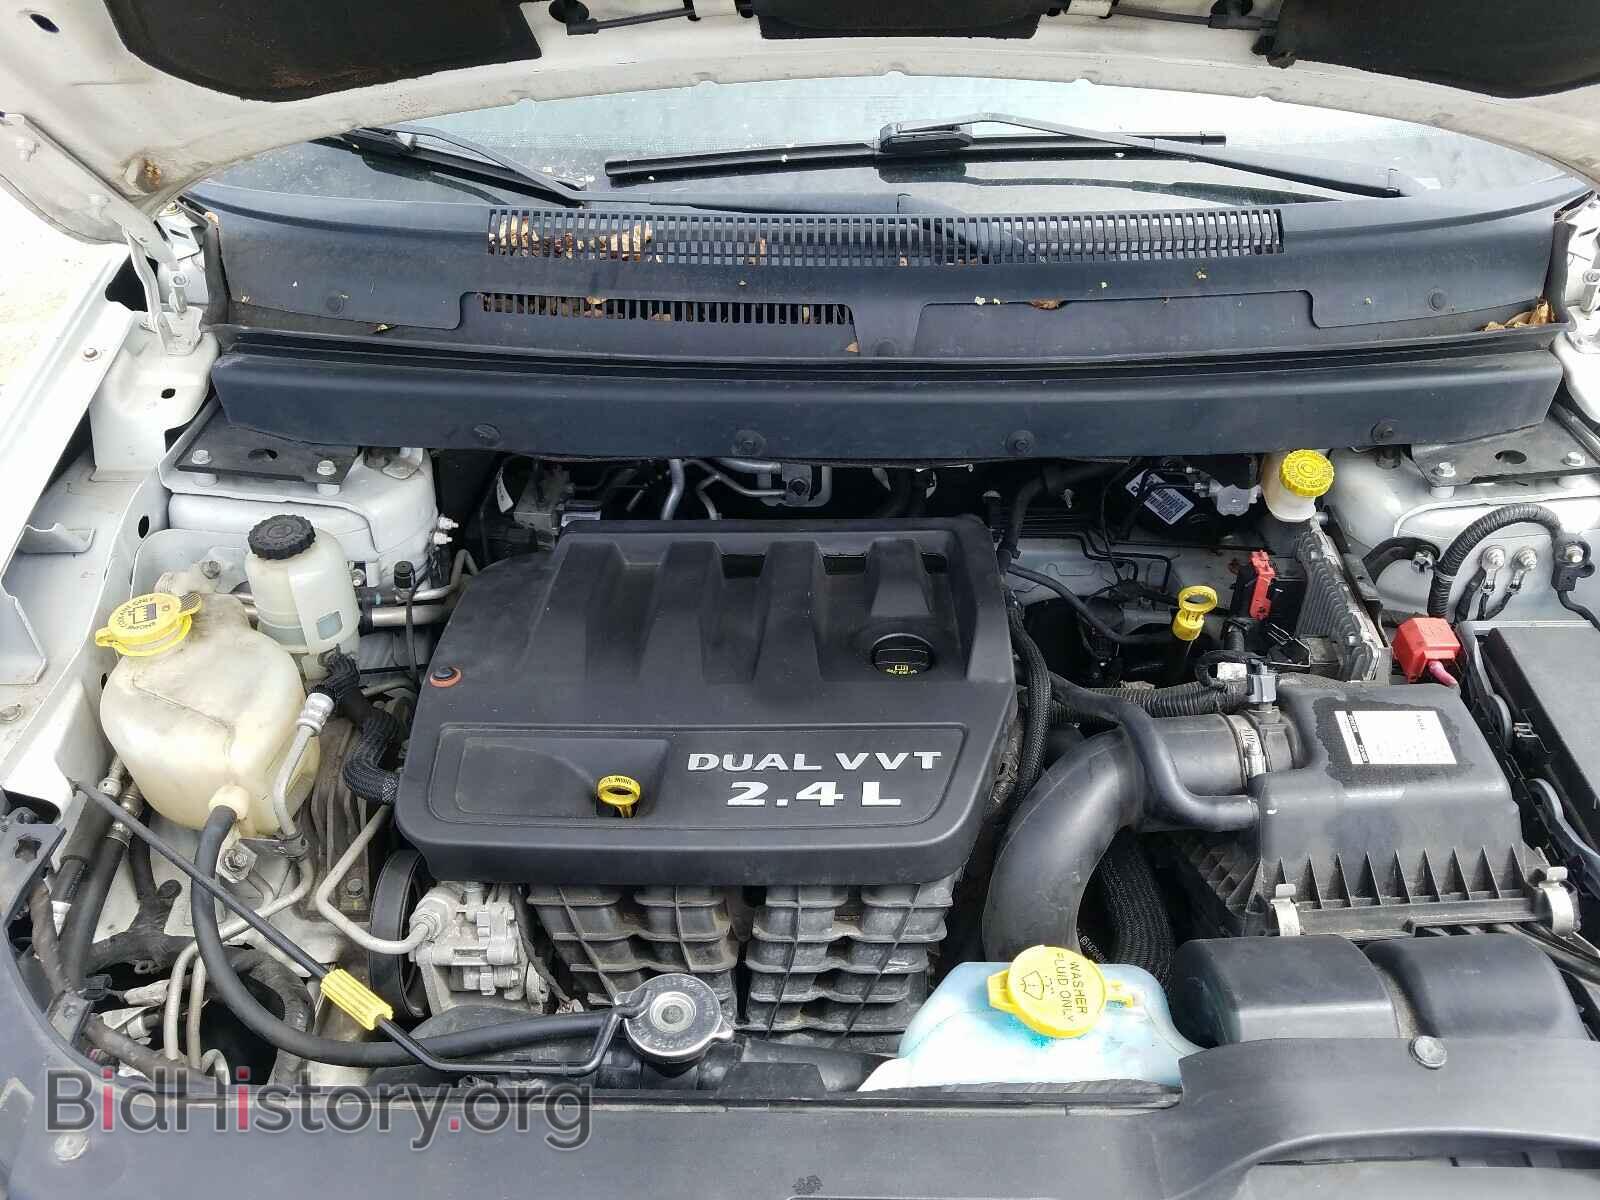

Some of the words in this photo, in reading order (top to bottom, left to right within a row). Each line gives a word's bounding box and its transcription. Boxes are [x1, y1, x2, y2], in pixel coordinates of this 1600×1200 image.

[687, 752, 822, 771] DUAL
[835, 751, 942, 770] VVT
[1054, 952, 1069, 986] FLUID
[1069, 961, 1088, 1015] WASHER
[1060, 990, 1075, 1022] ONLY
